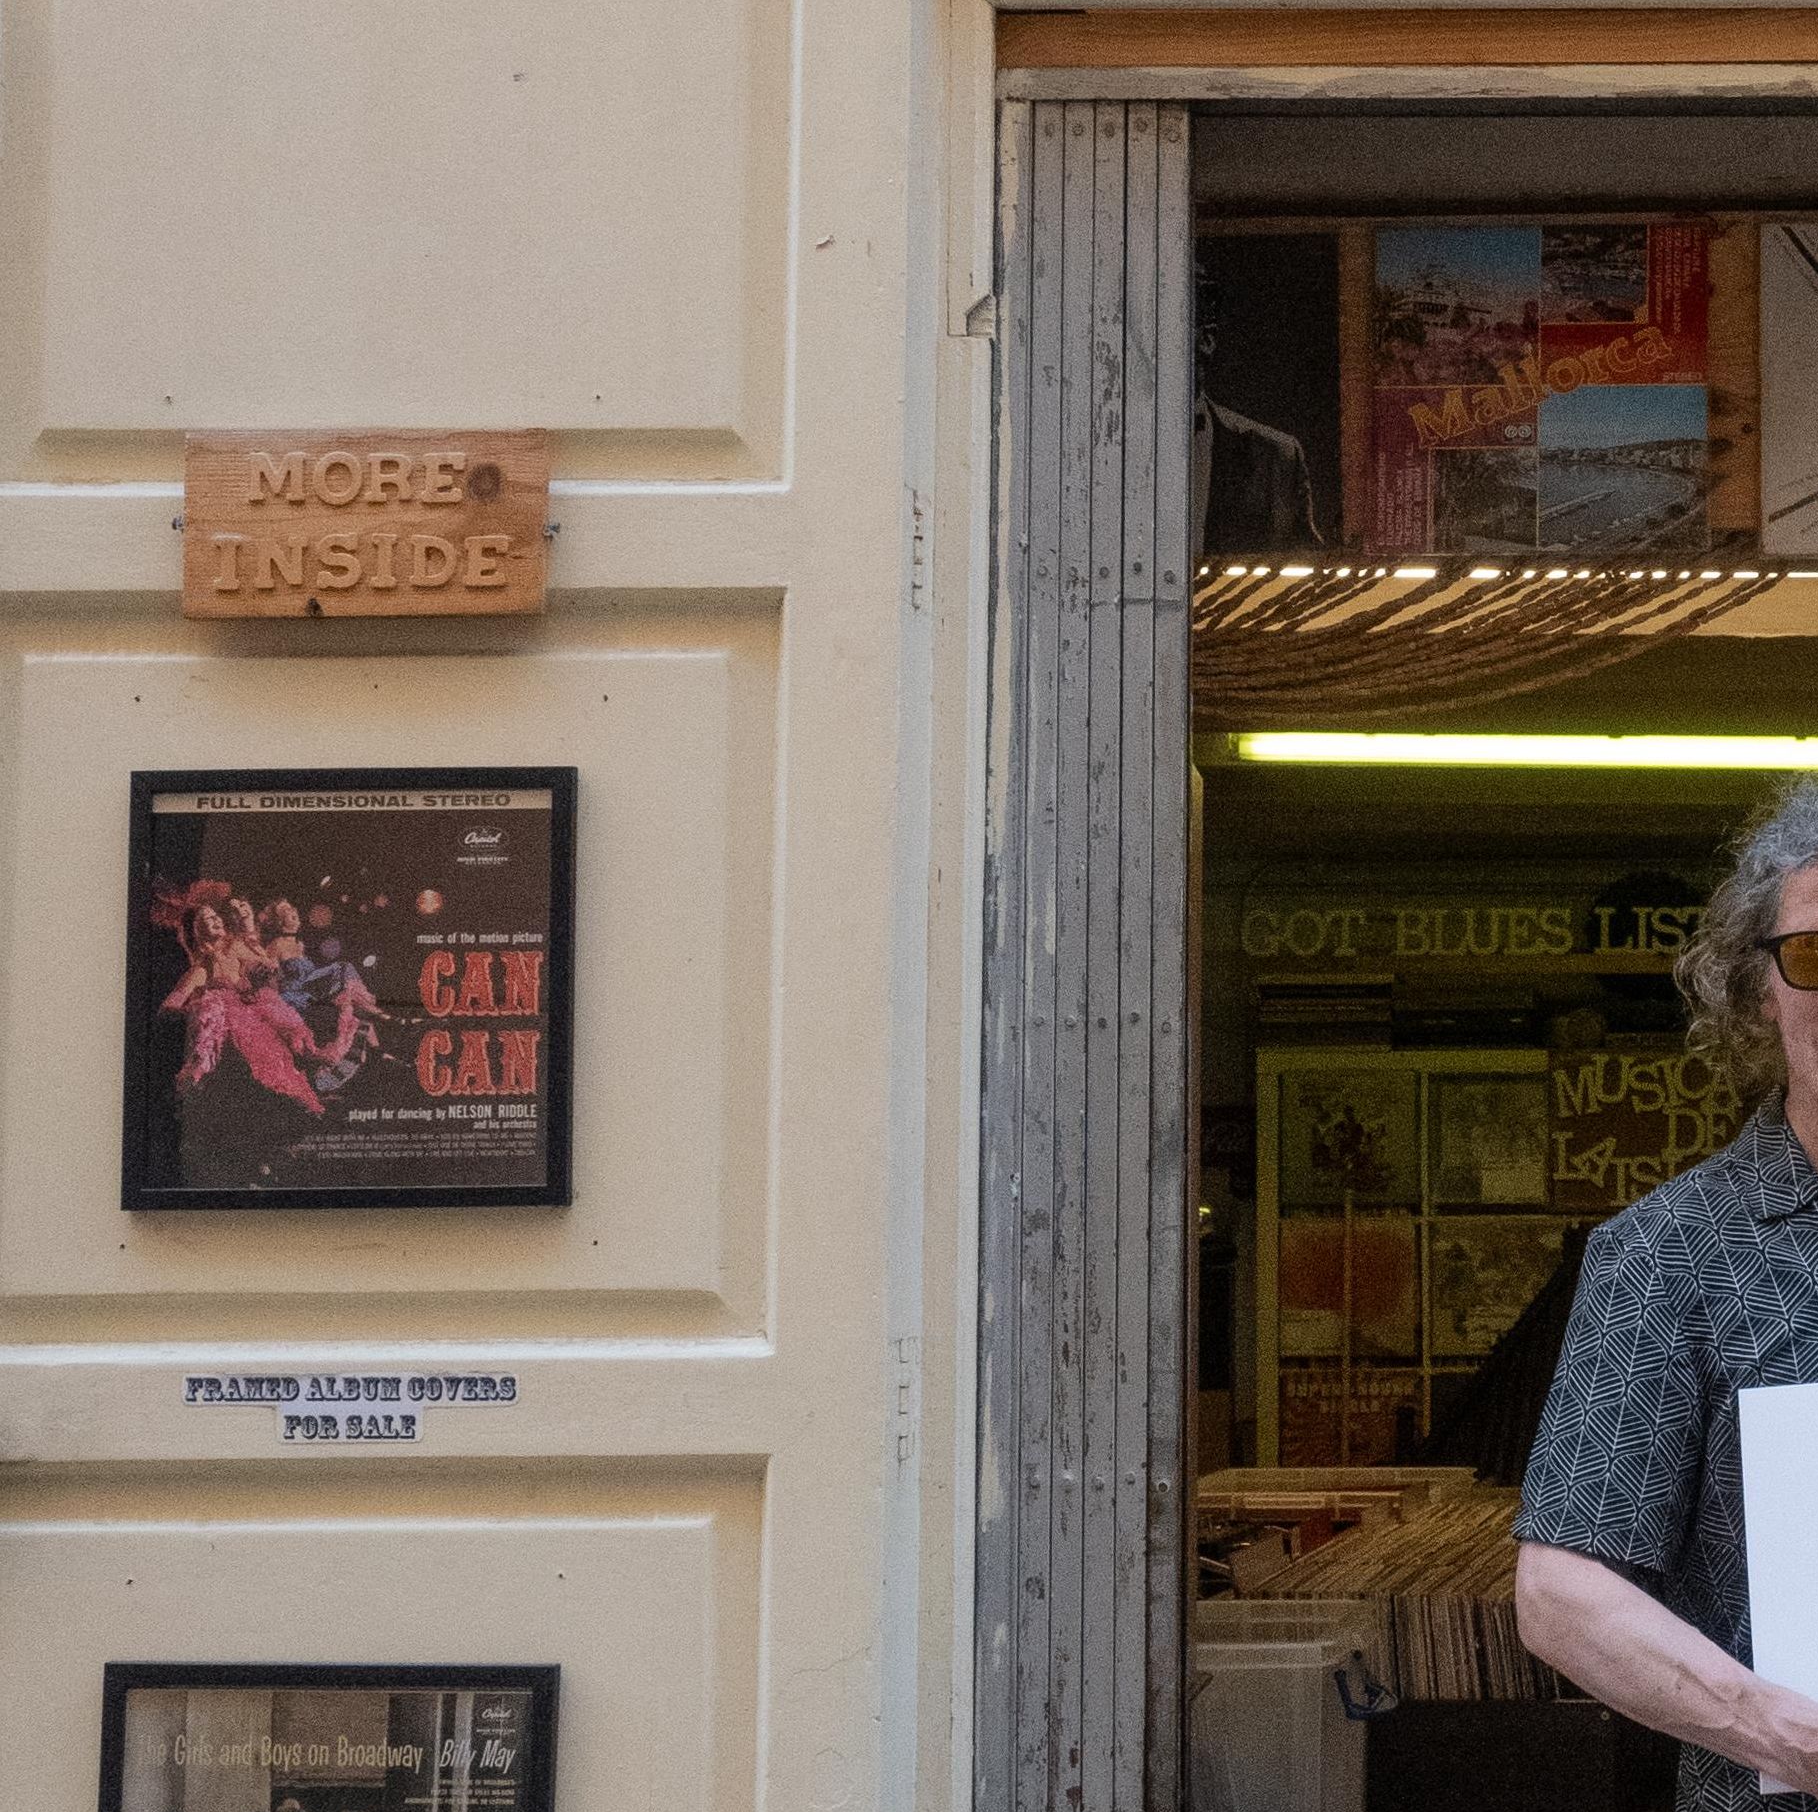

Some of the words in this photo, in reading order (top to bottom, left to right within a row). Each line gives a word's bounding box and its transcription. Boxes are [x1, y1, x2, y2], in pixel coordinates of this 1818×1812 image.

[1407, 326, 1673, 449] Mallorca
[249, 451, 467, 506] MORE
[211, 532, 511, 591] INSIDE
[197, 796, 251, 809] FULL
[260, 794, 414, 809] DIMENSIONAL
[423, 793, 512, 807] STEREO
[416, 933, 444, 944] music
[447, 932, 457, 944] of
[461, 932, 476, 944] the
[479, 932, 509, 944] motion
[512, 931, 543, 945] picture
[1241, 908, 1366, 957] GOT
[1392, 907, 1574, 956] BLUES
[418, 950, 544, 1017] CAN
[415, 1029, 541, 1097] CAN
[349, 1108, 377, 1122] played
[381, 1108, 394, 1120] for
[398, 1107, 432, 1122] dancing
[436, 1107, 446, 1121] by
[448, 1104, 491, 1118] NELSON
[498, 1103, 537, 1118] RIDDLE
[185, 1376, 300, 1402] FRAMED
[305, 1376, 402, 1401] ALBUM
[407, 1376, 517, 1402] COVERS
[283, 1414, 339, 1440] FOR
[346, 1414, 416, 1440] SALE
[219, 1734, 253, 1766] and
[260, 1735, 301, 1772] Boys
[308, 1743, 330, 1766] on
[337, 1735, 423, 1774] Broadway
[440, 1739, 477, 1773] Billy
[480, 1739, 516, 1774] May
